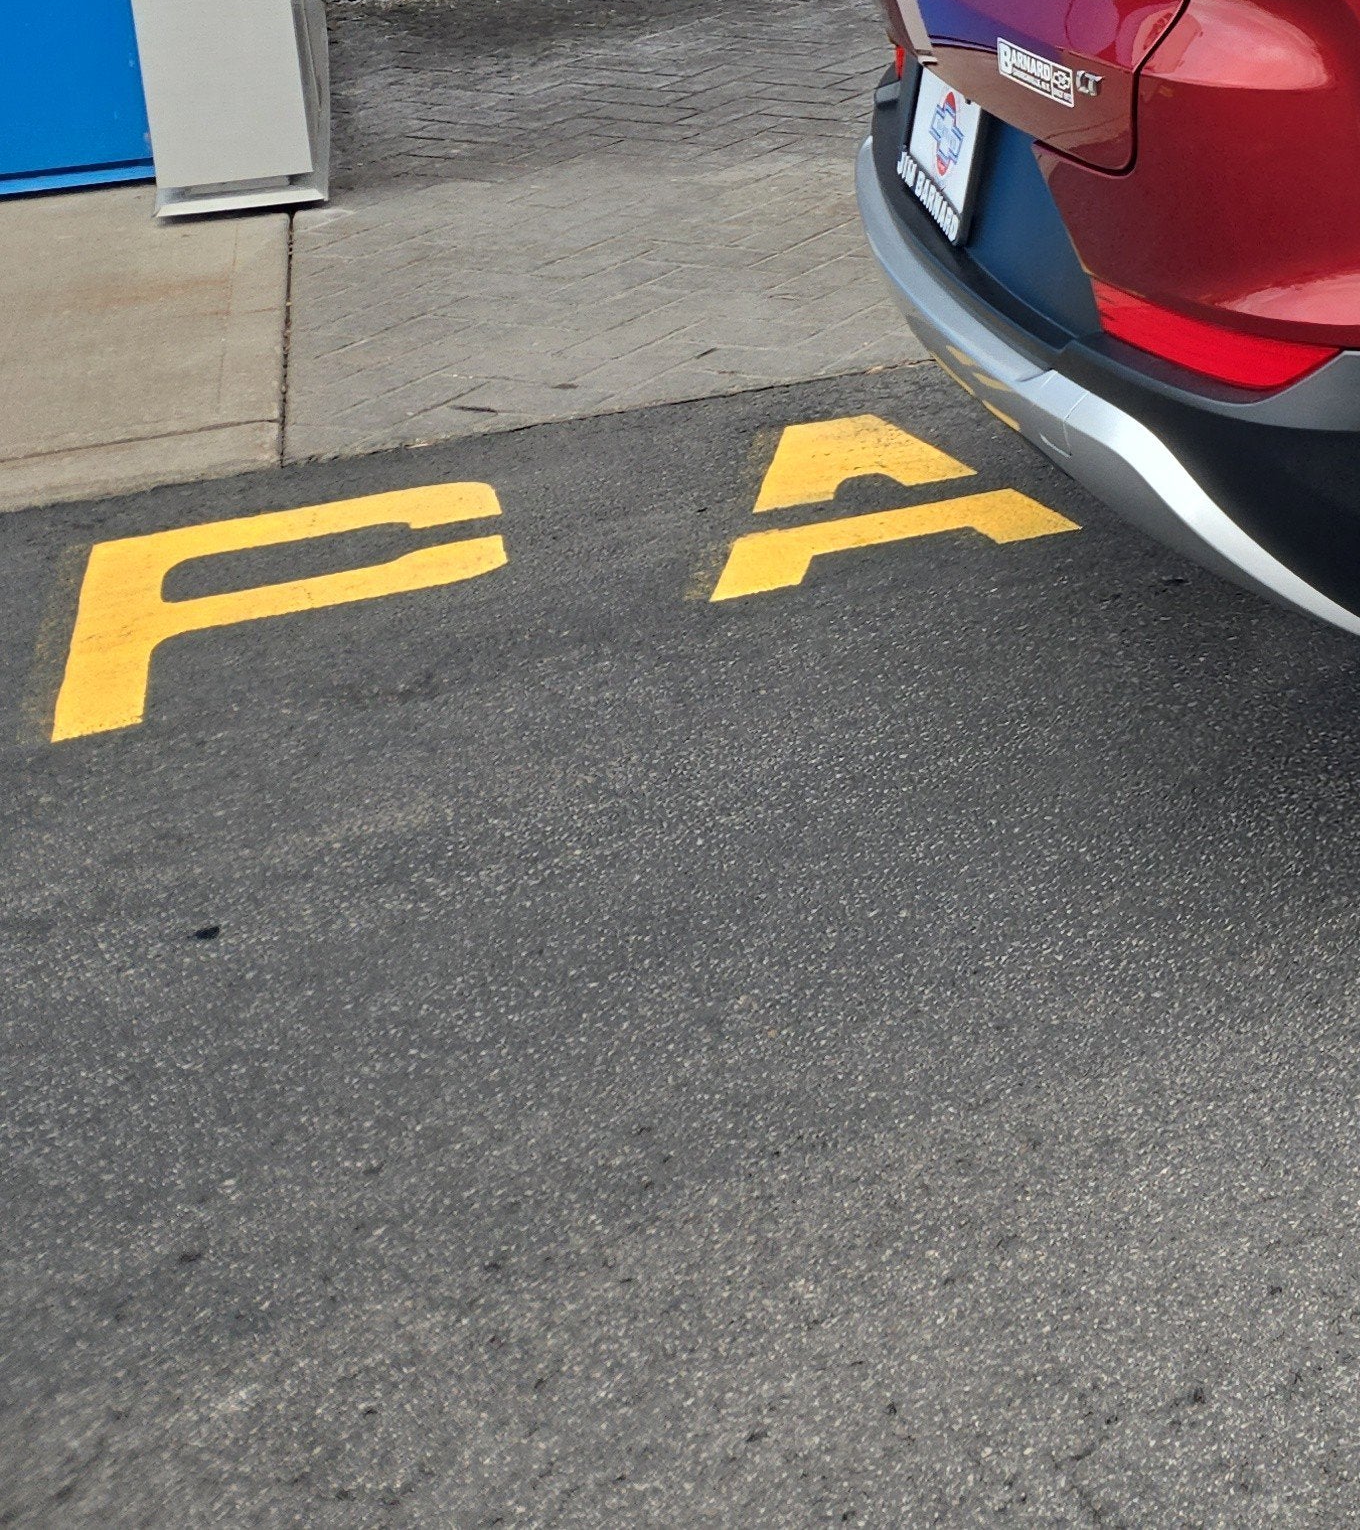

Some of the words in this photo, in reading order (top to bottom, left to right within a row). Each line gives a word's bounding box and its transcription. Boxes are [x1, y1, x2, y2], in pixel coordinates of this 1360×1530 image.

[999, 40, 1051, 82] BARNARD
[1075, 70, 1104, 97] LT
[896, 151, 918, 188] JIM
[914, 170, 960, 242] BARNARD
